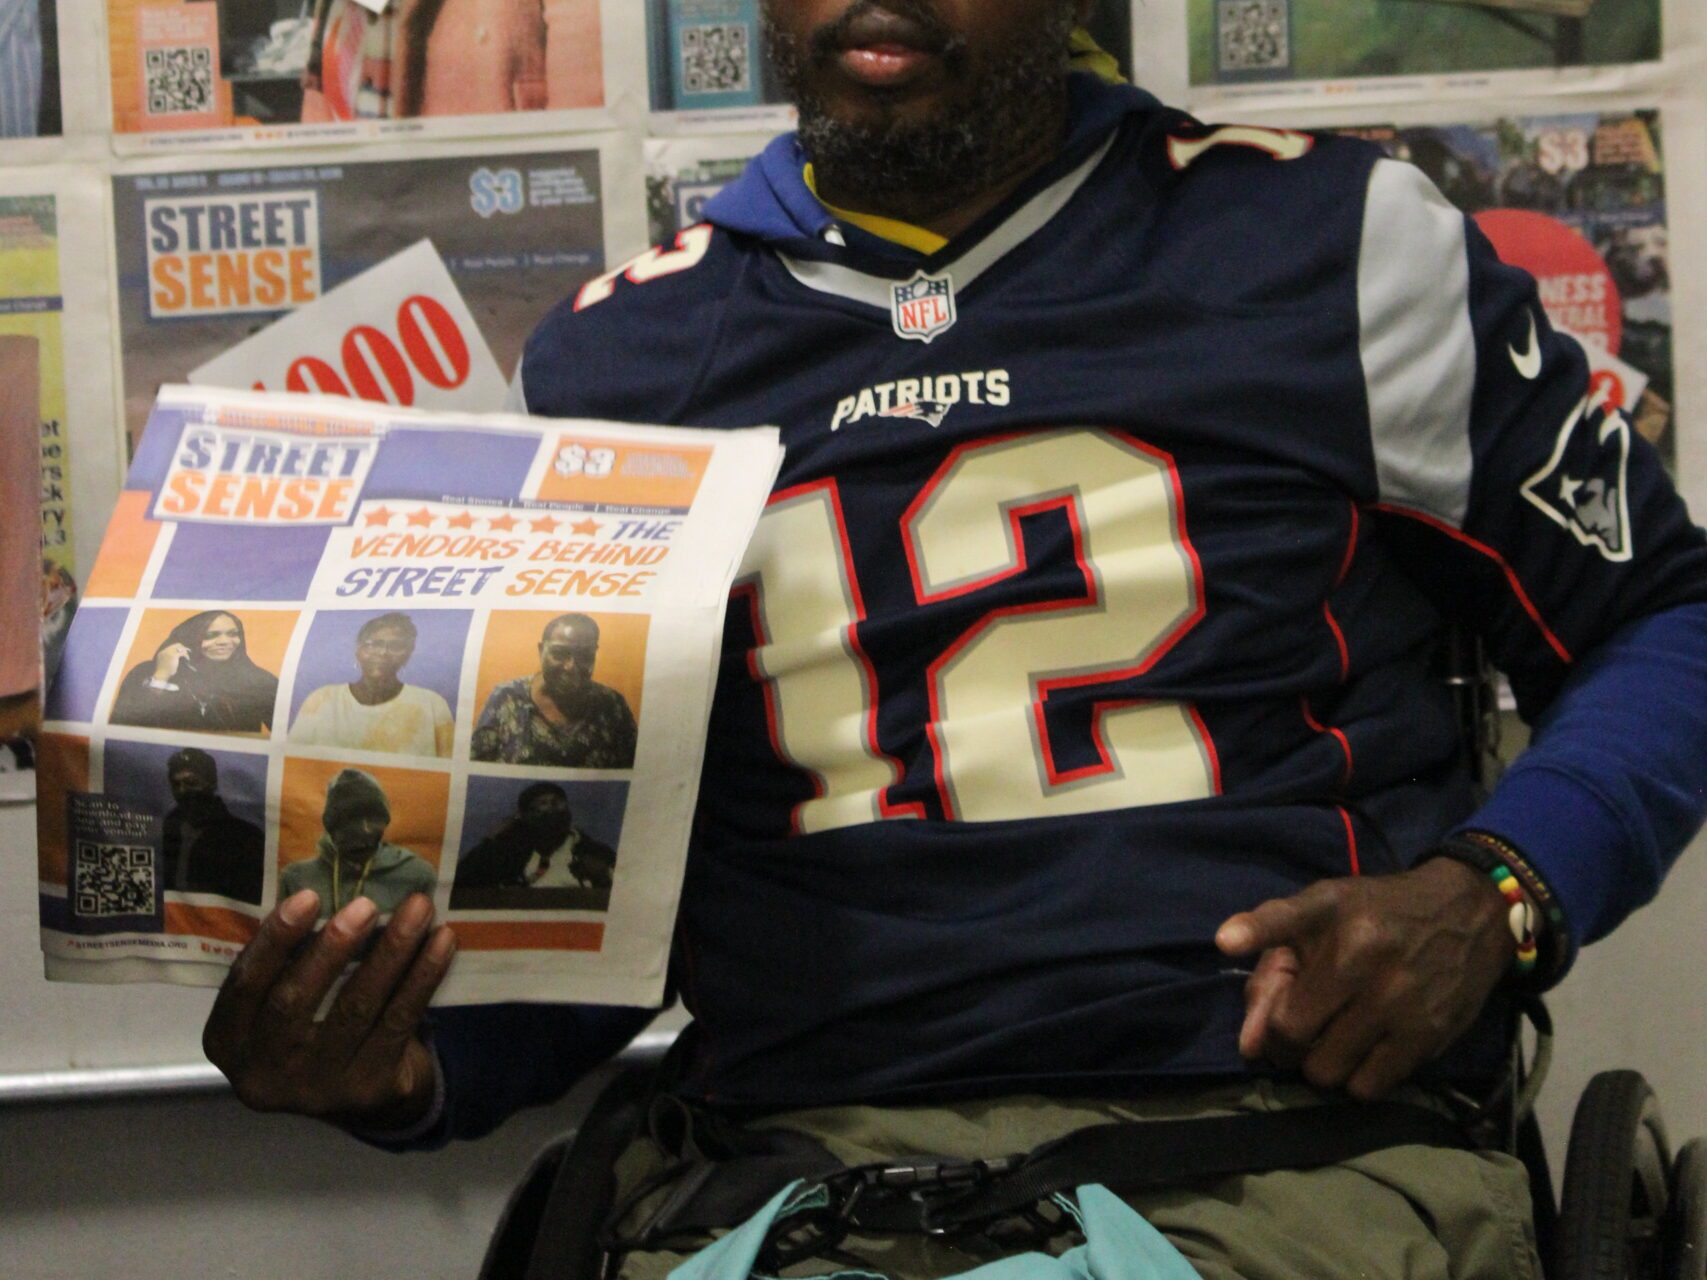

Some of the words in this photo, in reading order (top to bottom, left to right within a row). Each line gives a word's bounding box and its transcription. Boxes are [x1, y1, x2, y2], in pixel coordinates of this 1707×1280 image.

[1538, 129, 1590, 175] $3
[470, 167, 523, 217] $3
[150, 199, 311, 253] STREET
[152, 248, 317, 312] SENSE
[901, 297, 947, 330] NFL
[830, 368, 1011, 432] PATRIOTS
[179, 429, 371, 477] STREET
[554, 442, 616, 478] $3
[162, 468, 355, 520] SENSE
[441, 495, 465, 505] Real
[523, 501, 548, 510] Real
[605, 504, 630, 514] Real
[350, 533, 525, 560] VENDORS
[610, 520, 683, 540] THE
[335, 565, 505, 599] STREET
[505, 568, 658, 598] SENSE
[727, 426, 1223, 837] 12
